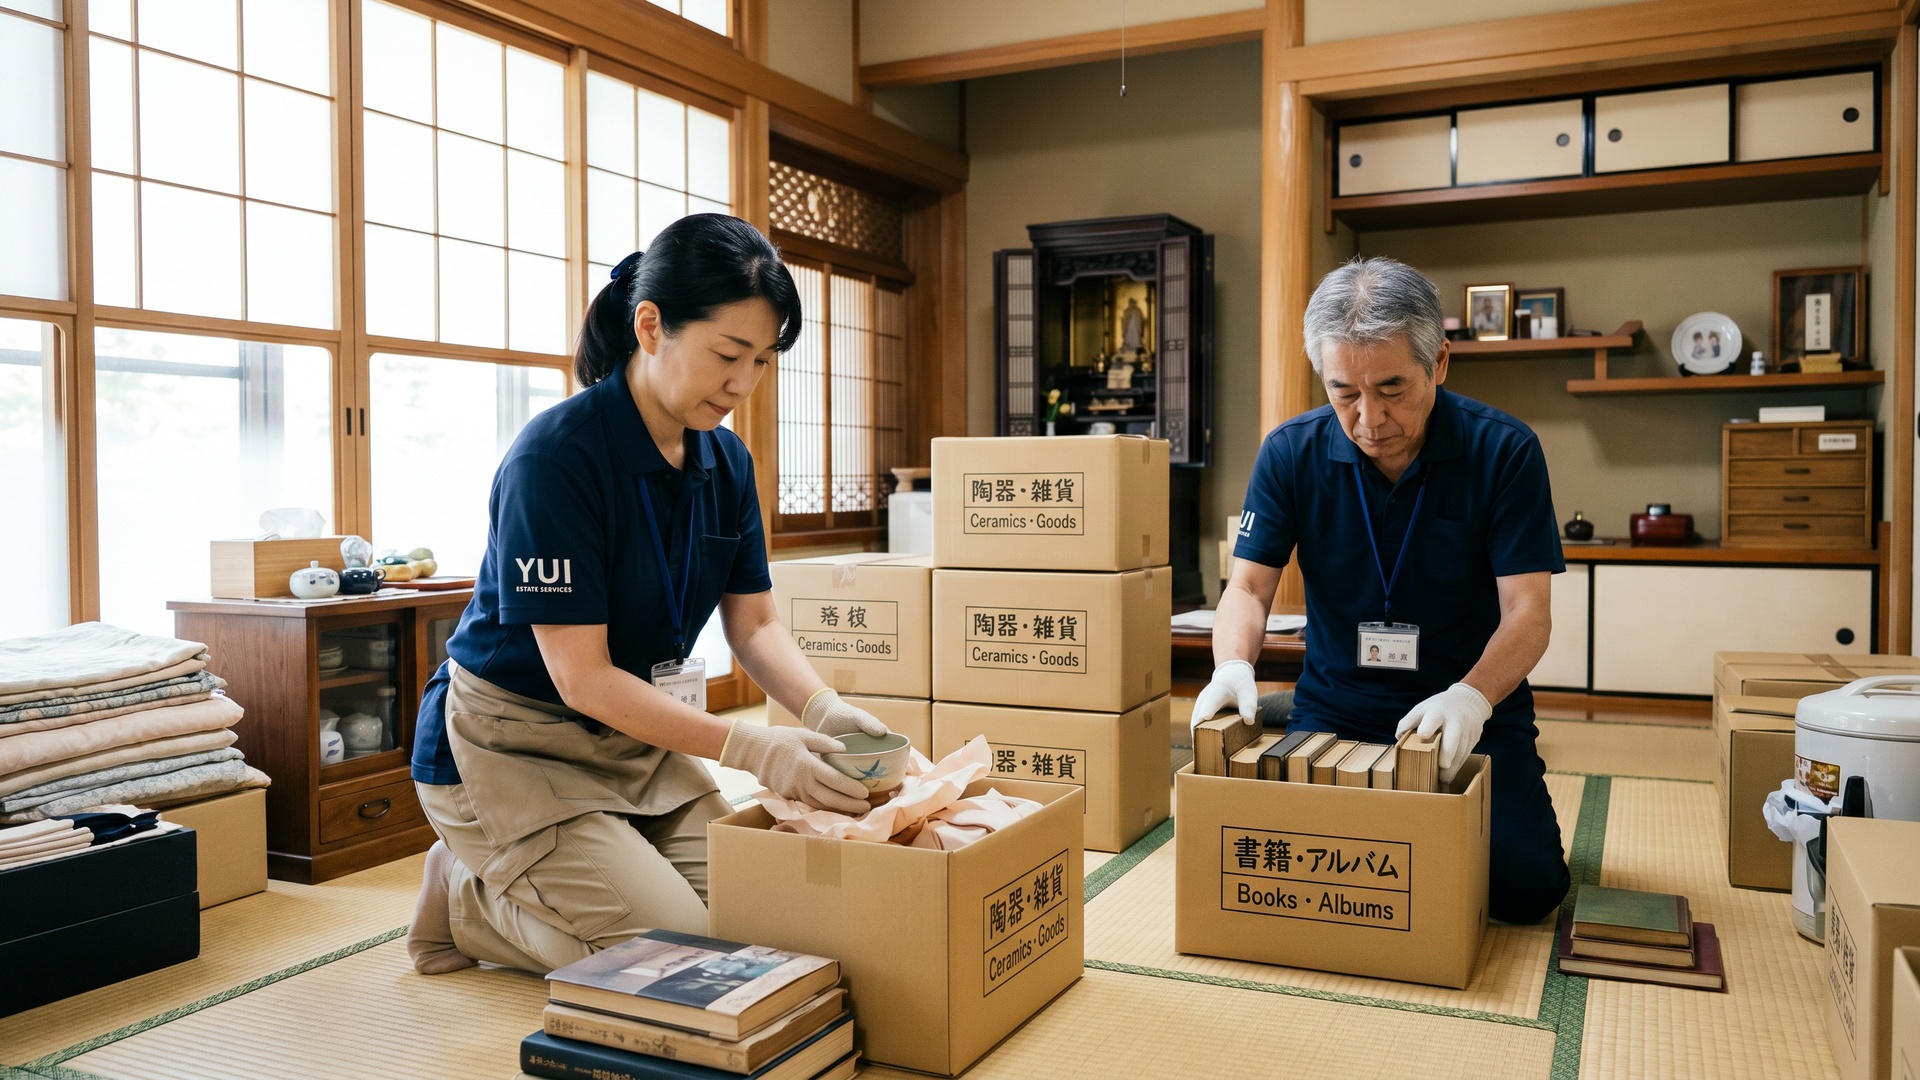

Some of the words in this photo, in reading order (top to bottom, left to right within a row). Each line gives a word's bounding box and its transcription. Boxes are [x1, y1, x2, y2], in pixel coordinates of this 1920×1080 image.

[972, 478, 1075, 503] 陶器・雑貨
[970, 513, 1027, 528] Ceramics
[1036, 513, 1077, 529] Goods
[1240, 509, 1256, 531] UI
[515, 557, 571, 584] YUI
[973, 613, 1078, 642] 陶器・雑貨
[797, 636, 848, 652] Ceramics
[856, 638, 892, 654] Goods
[972, 646, 1028, 664] Ceramics
[1039, 649, 1079, 667] Goods
[990, 749, 1077, 780] 器・雑貨
[1233, 835, 1399, 879] 書籍・アルバム
[989, 862, 1064, 940] 陶器・雑貨
[1237, 882, 1298, 910] Books
[1318, 891, 1394, 921] Albums
[989, 938, 1032, 982] Ceramics
[1038, 913, 1065, 947] Goods
